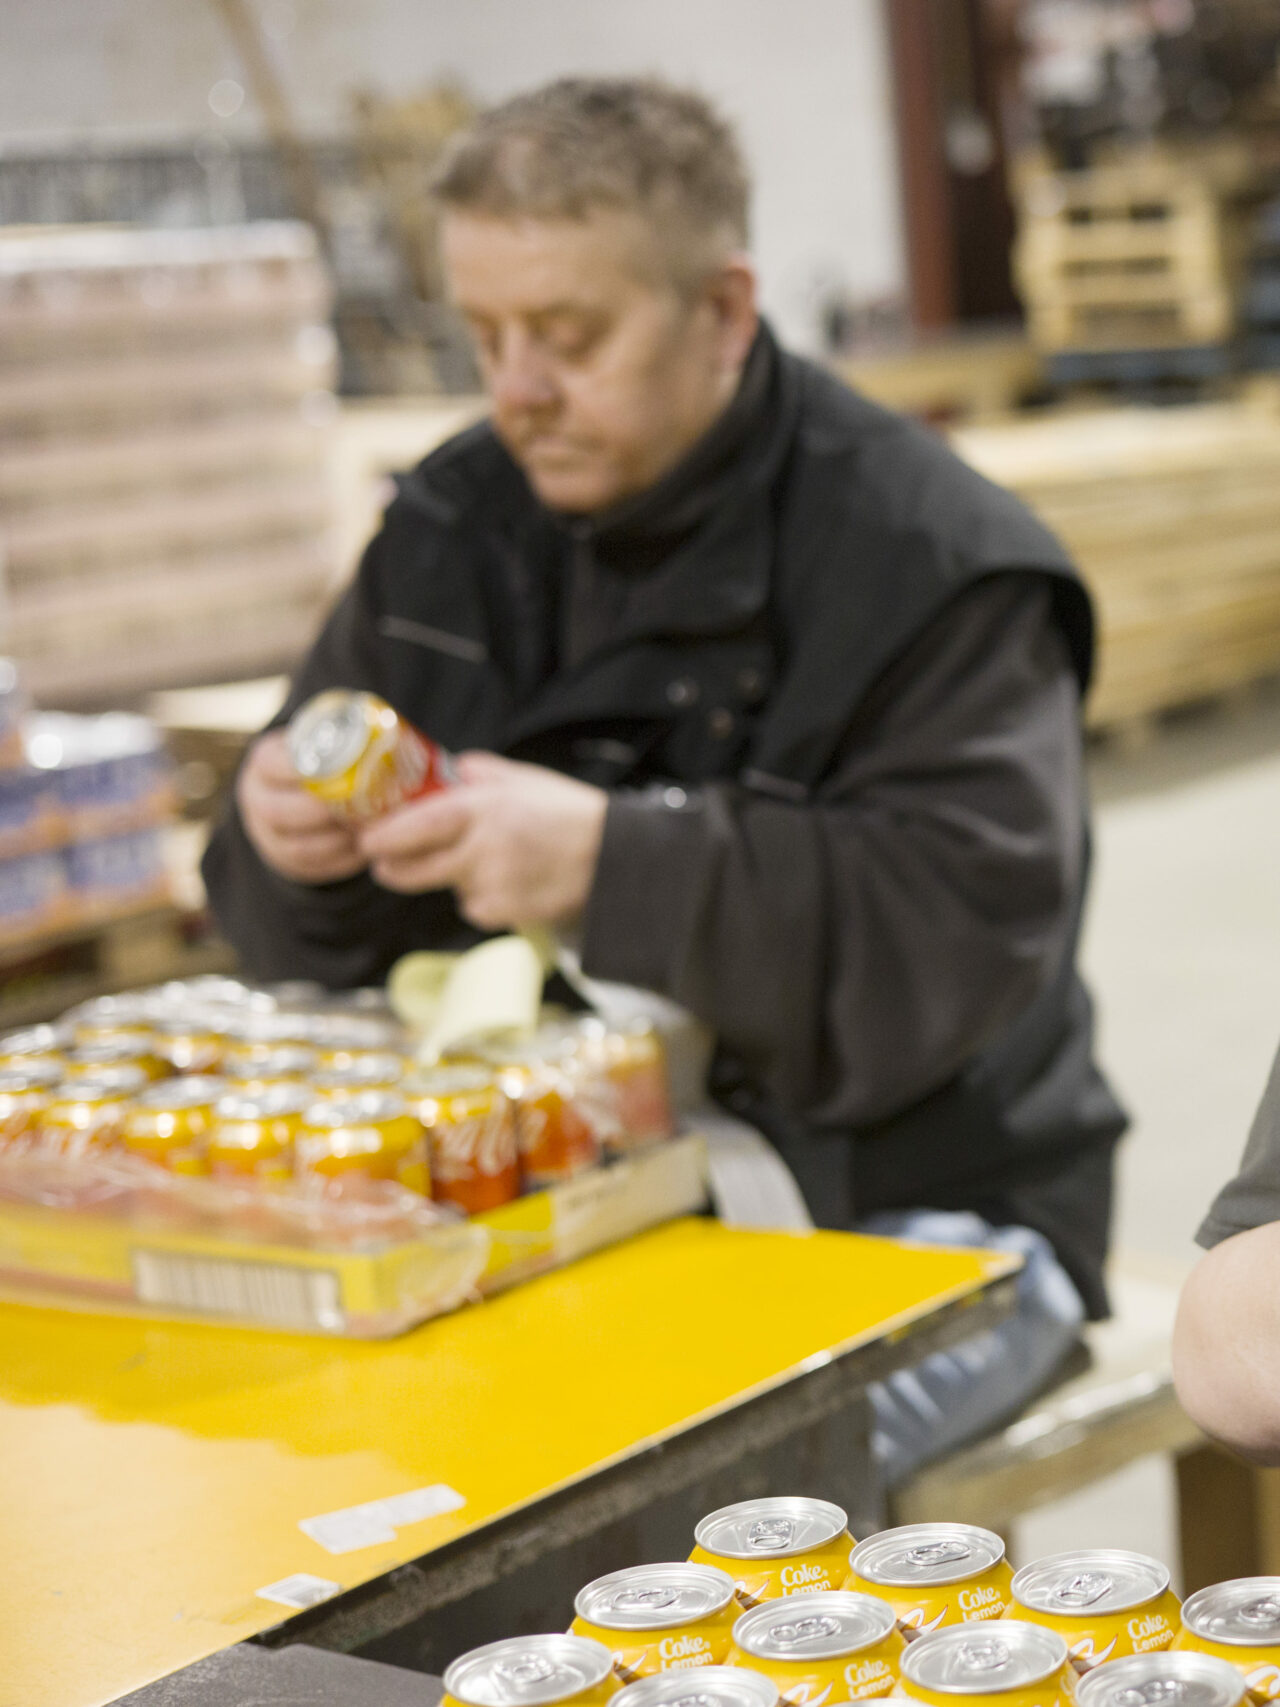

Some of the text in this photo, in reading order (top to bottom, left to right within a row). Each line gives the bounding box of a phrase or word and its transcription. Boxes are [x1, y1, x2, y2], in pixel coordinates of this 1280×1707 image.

[781, 1563, 824, 1587] Coke
[782, 1579, 832, 1598] Lemon
[958, 1586, 997, 1610] Coke
[962, 1601, 1006, 1622] Lemon
[1127, 1614, 1166, 1640] Coke
[659, 1635, 705, 1660] Coke
[1132, 1629, 1175, 1654] Lemon
[661, 1652, 714, 1673] Lemon
[844, 1659, 886, 1686] Coke
[848, 1674, 896, 1700] Lemon
